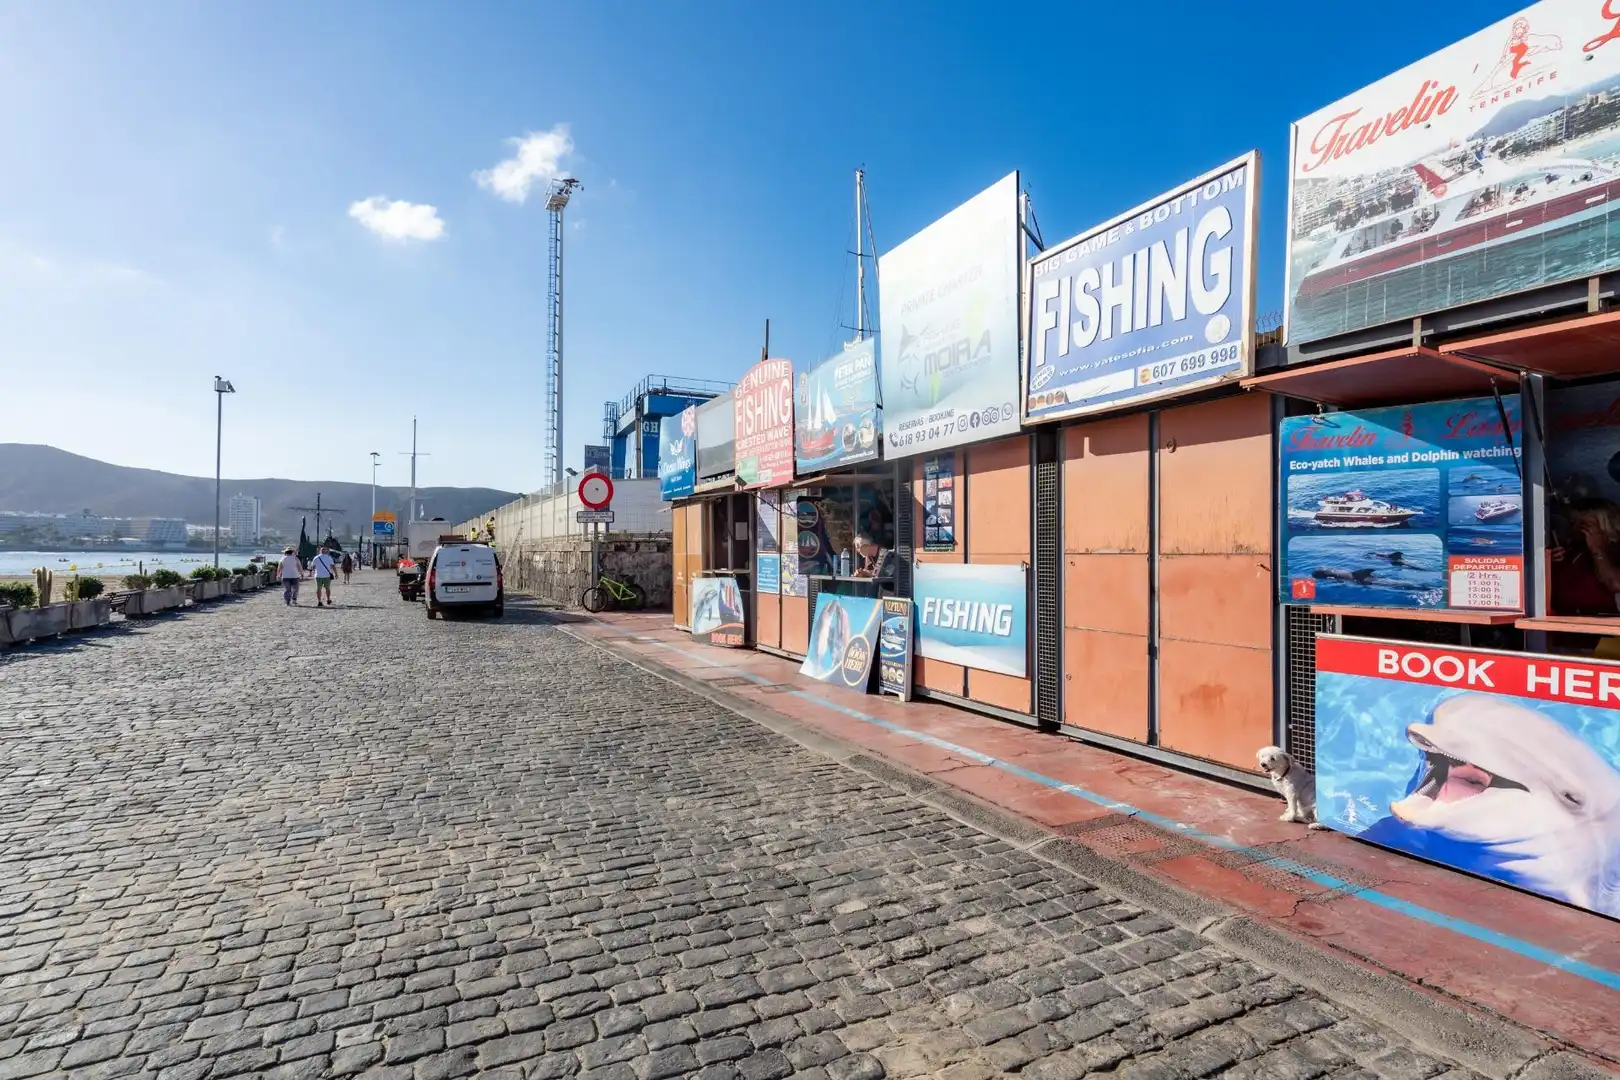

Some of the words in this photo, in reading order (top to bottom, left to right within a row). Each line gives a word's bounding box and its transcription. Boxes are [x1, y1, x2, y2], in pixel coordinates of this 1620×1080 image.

[1468, 71, 1558, 113] TENERIFE
[1303, 79, 1459, 172] Travelin
[1034, 259, 1062, 277] BIG
[1065, 227, 1121, 262] GAME
[1124, 223, 1135, 235] &
[1138, 168, 1245, 230] BOTTOM
[1035, 204, 1233, 368] FISHING
[1059, 334, 1194, 377] www.yatesofia.com
[1152, 361, 1176, 379] 607
[1180, 353, 1205, 373] 699
[1210, 345, 1238, 365] 998
[735, 361, 790, 399] GENUINE
[735, 378, 791, 441] FISHING
[898, 417, 924, 431] RESERVAS
[899, 432, 913, 447] 618
[915, 430, 926, 443] 93
[928, 426, 940, 440] 04
[943, 422, 955, 436] 77
[1289, 453, 1341, 470] Eco-yatch
[1343, 453, 1384, 467] Whales
[1387, 451, 1409, 464] and
[1412, 449, 1459, 464] Dolphin
[1463, 446, 1522, 460] watching
[921, 596, 1013, 637] FISHING
[1378, 648, 1496, 688] BOOK
